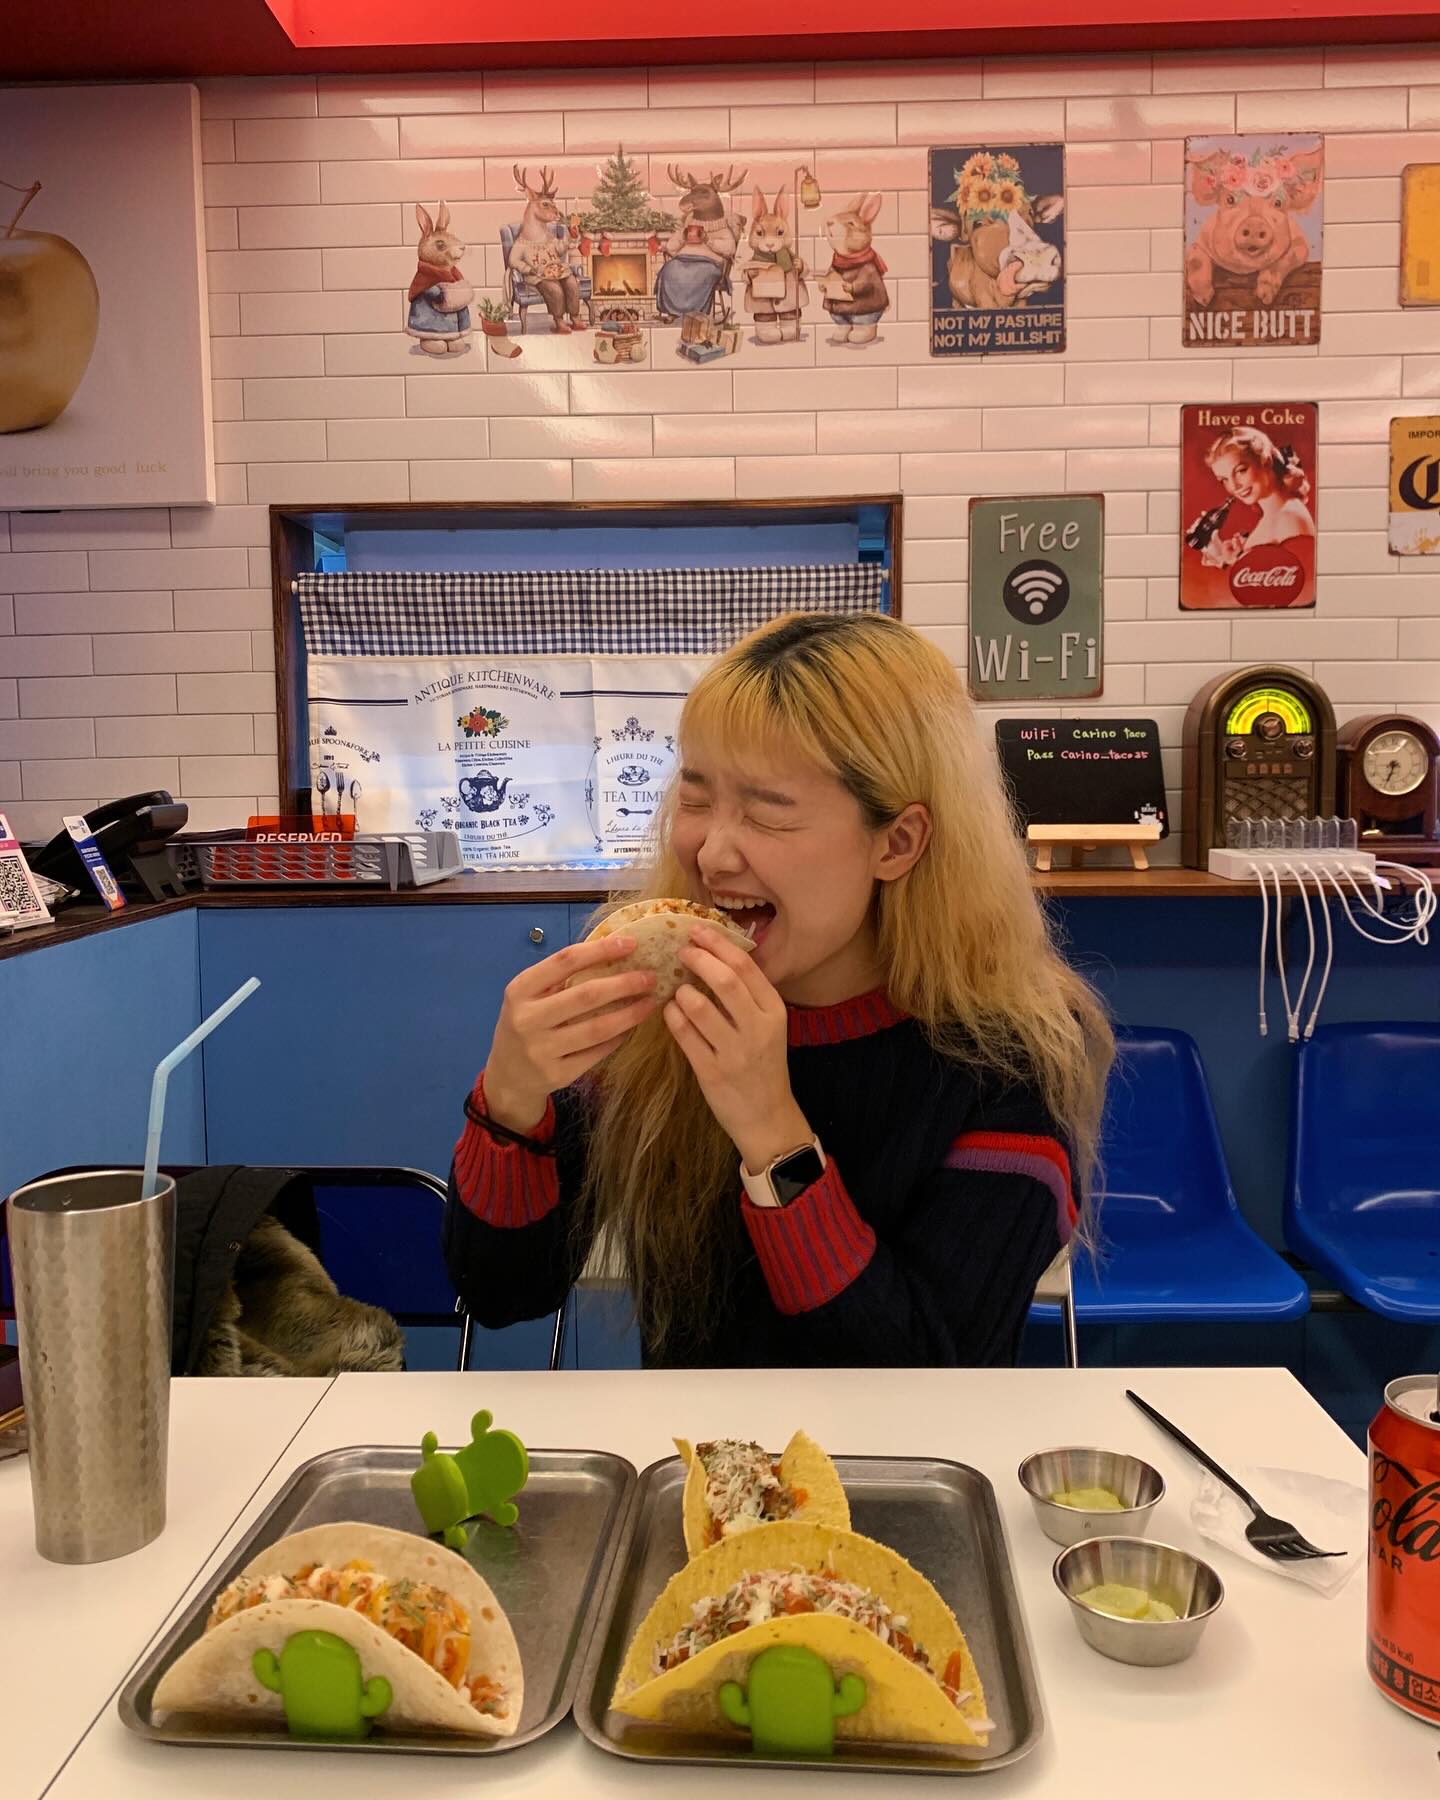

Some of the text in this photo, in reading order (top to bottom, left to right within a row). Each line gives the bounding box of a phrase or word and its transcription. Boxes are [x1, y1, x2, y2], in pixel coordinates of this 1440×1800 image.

[935, 313, 1062, 330] NOT MY PASTURE
[1189, 309, 1315, 340] NICE BUTT
[935, 330, 1062, 347] NOT MY BULLSHIT
[1198, 408, 1304, 426] Have a Coke
[64, 464, 88, 479] you
[94, 462, 126, 477] good
[136, 461, 167, 474] luck
[1000, 513, 1080, 552] Free
[974, 632, 1097, 682] Wi-Fi
[415, 669, 556, 704] ANTIQUE KITCHENWARE
[1021, 727, 1147, 741] WiFi Carino taco
[438, 739, 531, 751] LA PETITE CUISINE
[636, 752, 648, 761] DU
[1027, 749, 1054, 760] Pass
[603, 791, 627, 802] TEA
[481, 820, 500, 829] BLACK
[502, 818, 517, 827] TEA
[256, 832, 342, 842] RESERVED
